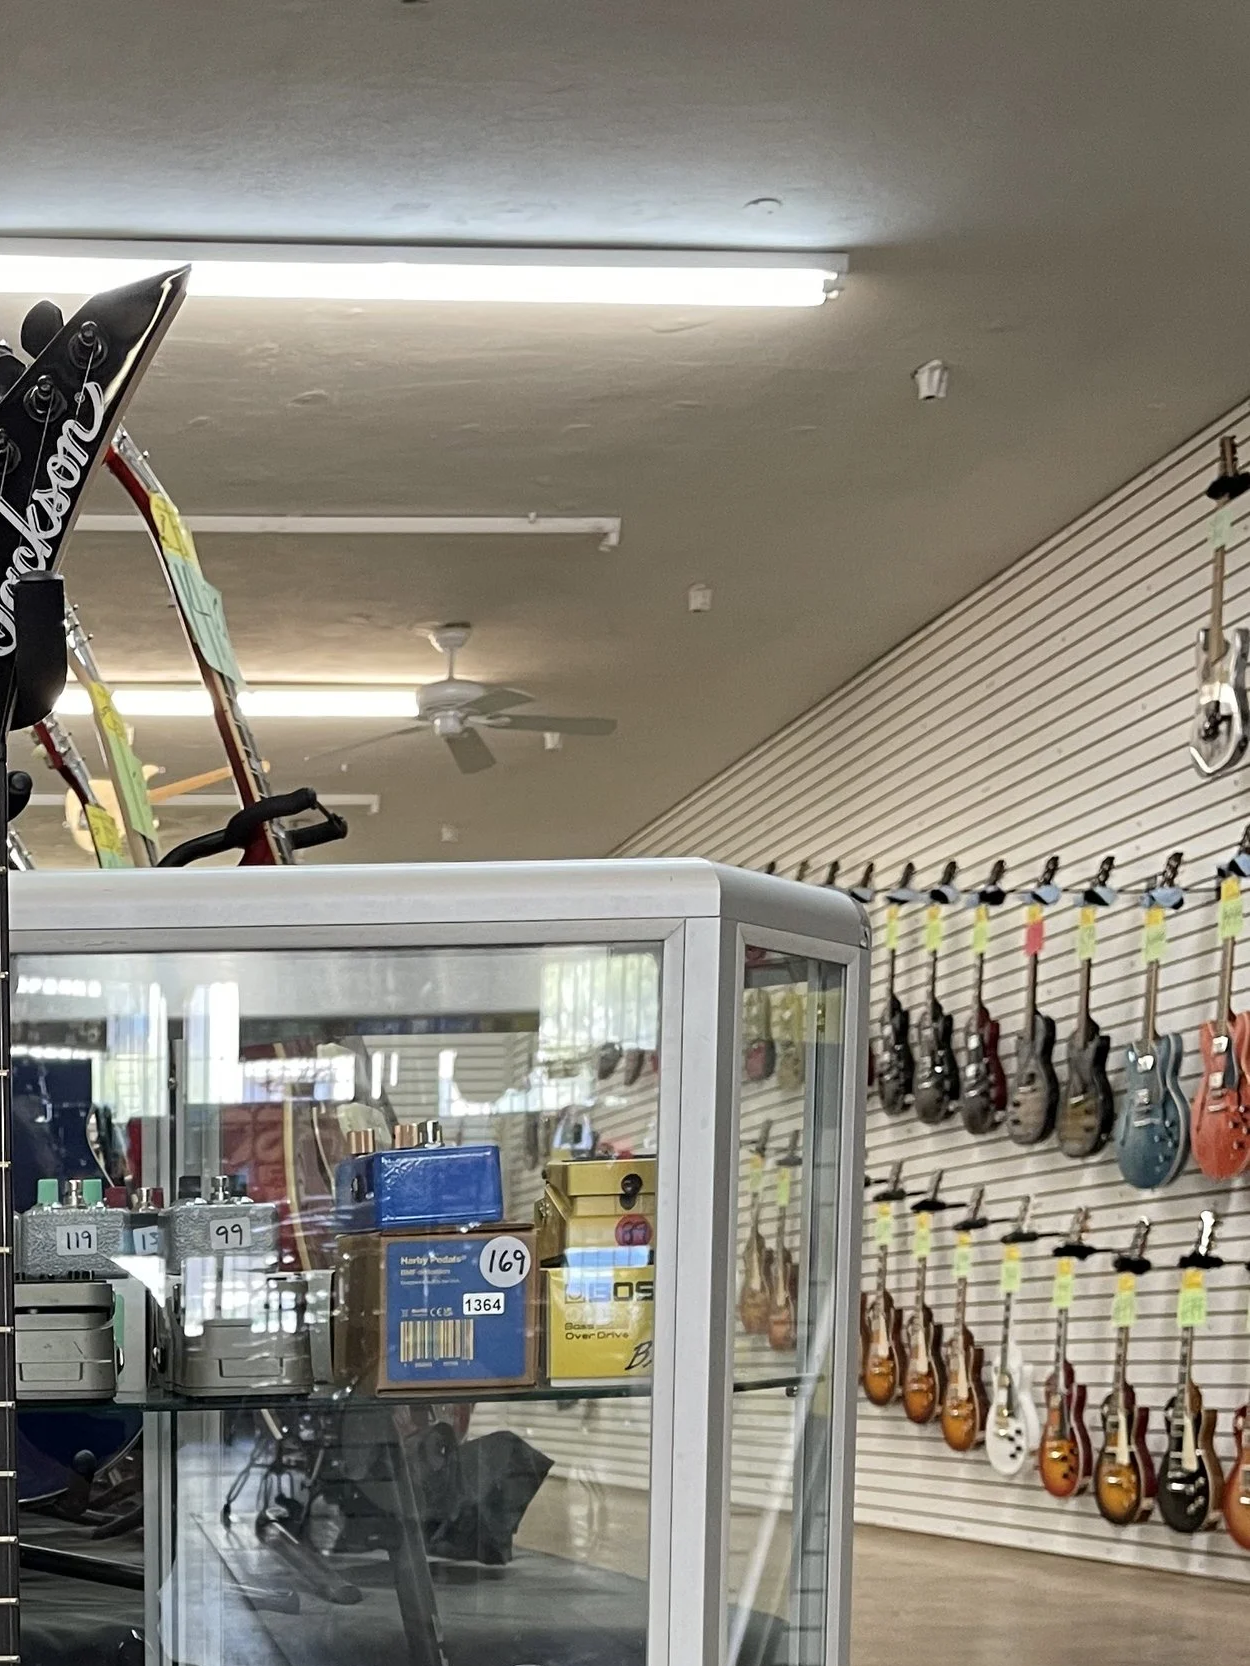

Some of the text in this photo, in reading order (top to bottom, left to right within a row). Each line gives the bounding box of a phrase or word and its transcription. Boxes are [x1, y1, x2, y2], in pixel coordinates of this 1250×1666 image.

[66, 1230, 92, 1250] 119
[216, 1223, 243, 1246] 99
[489, 1249, 525, 1275] 169
[465, 1298, 502, 1312] 1364
